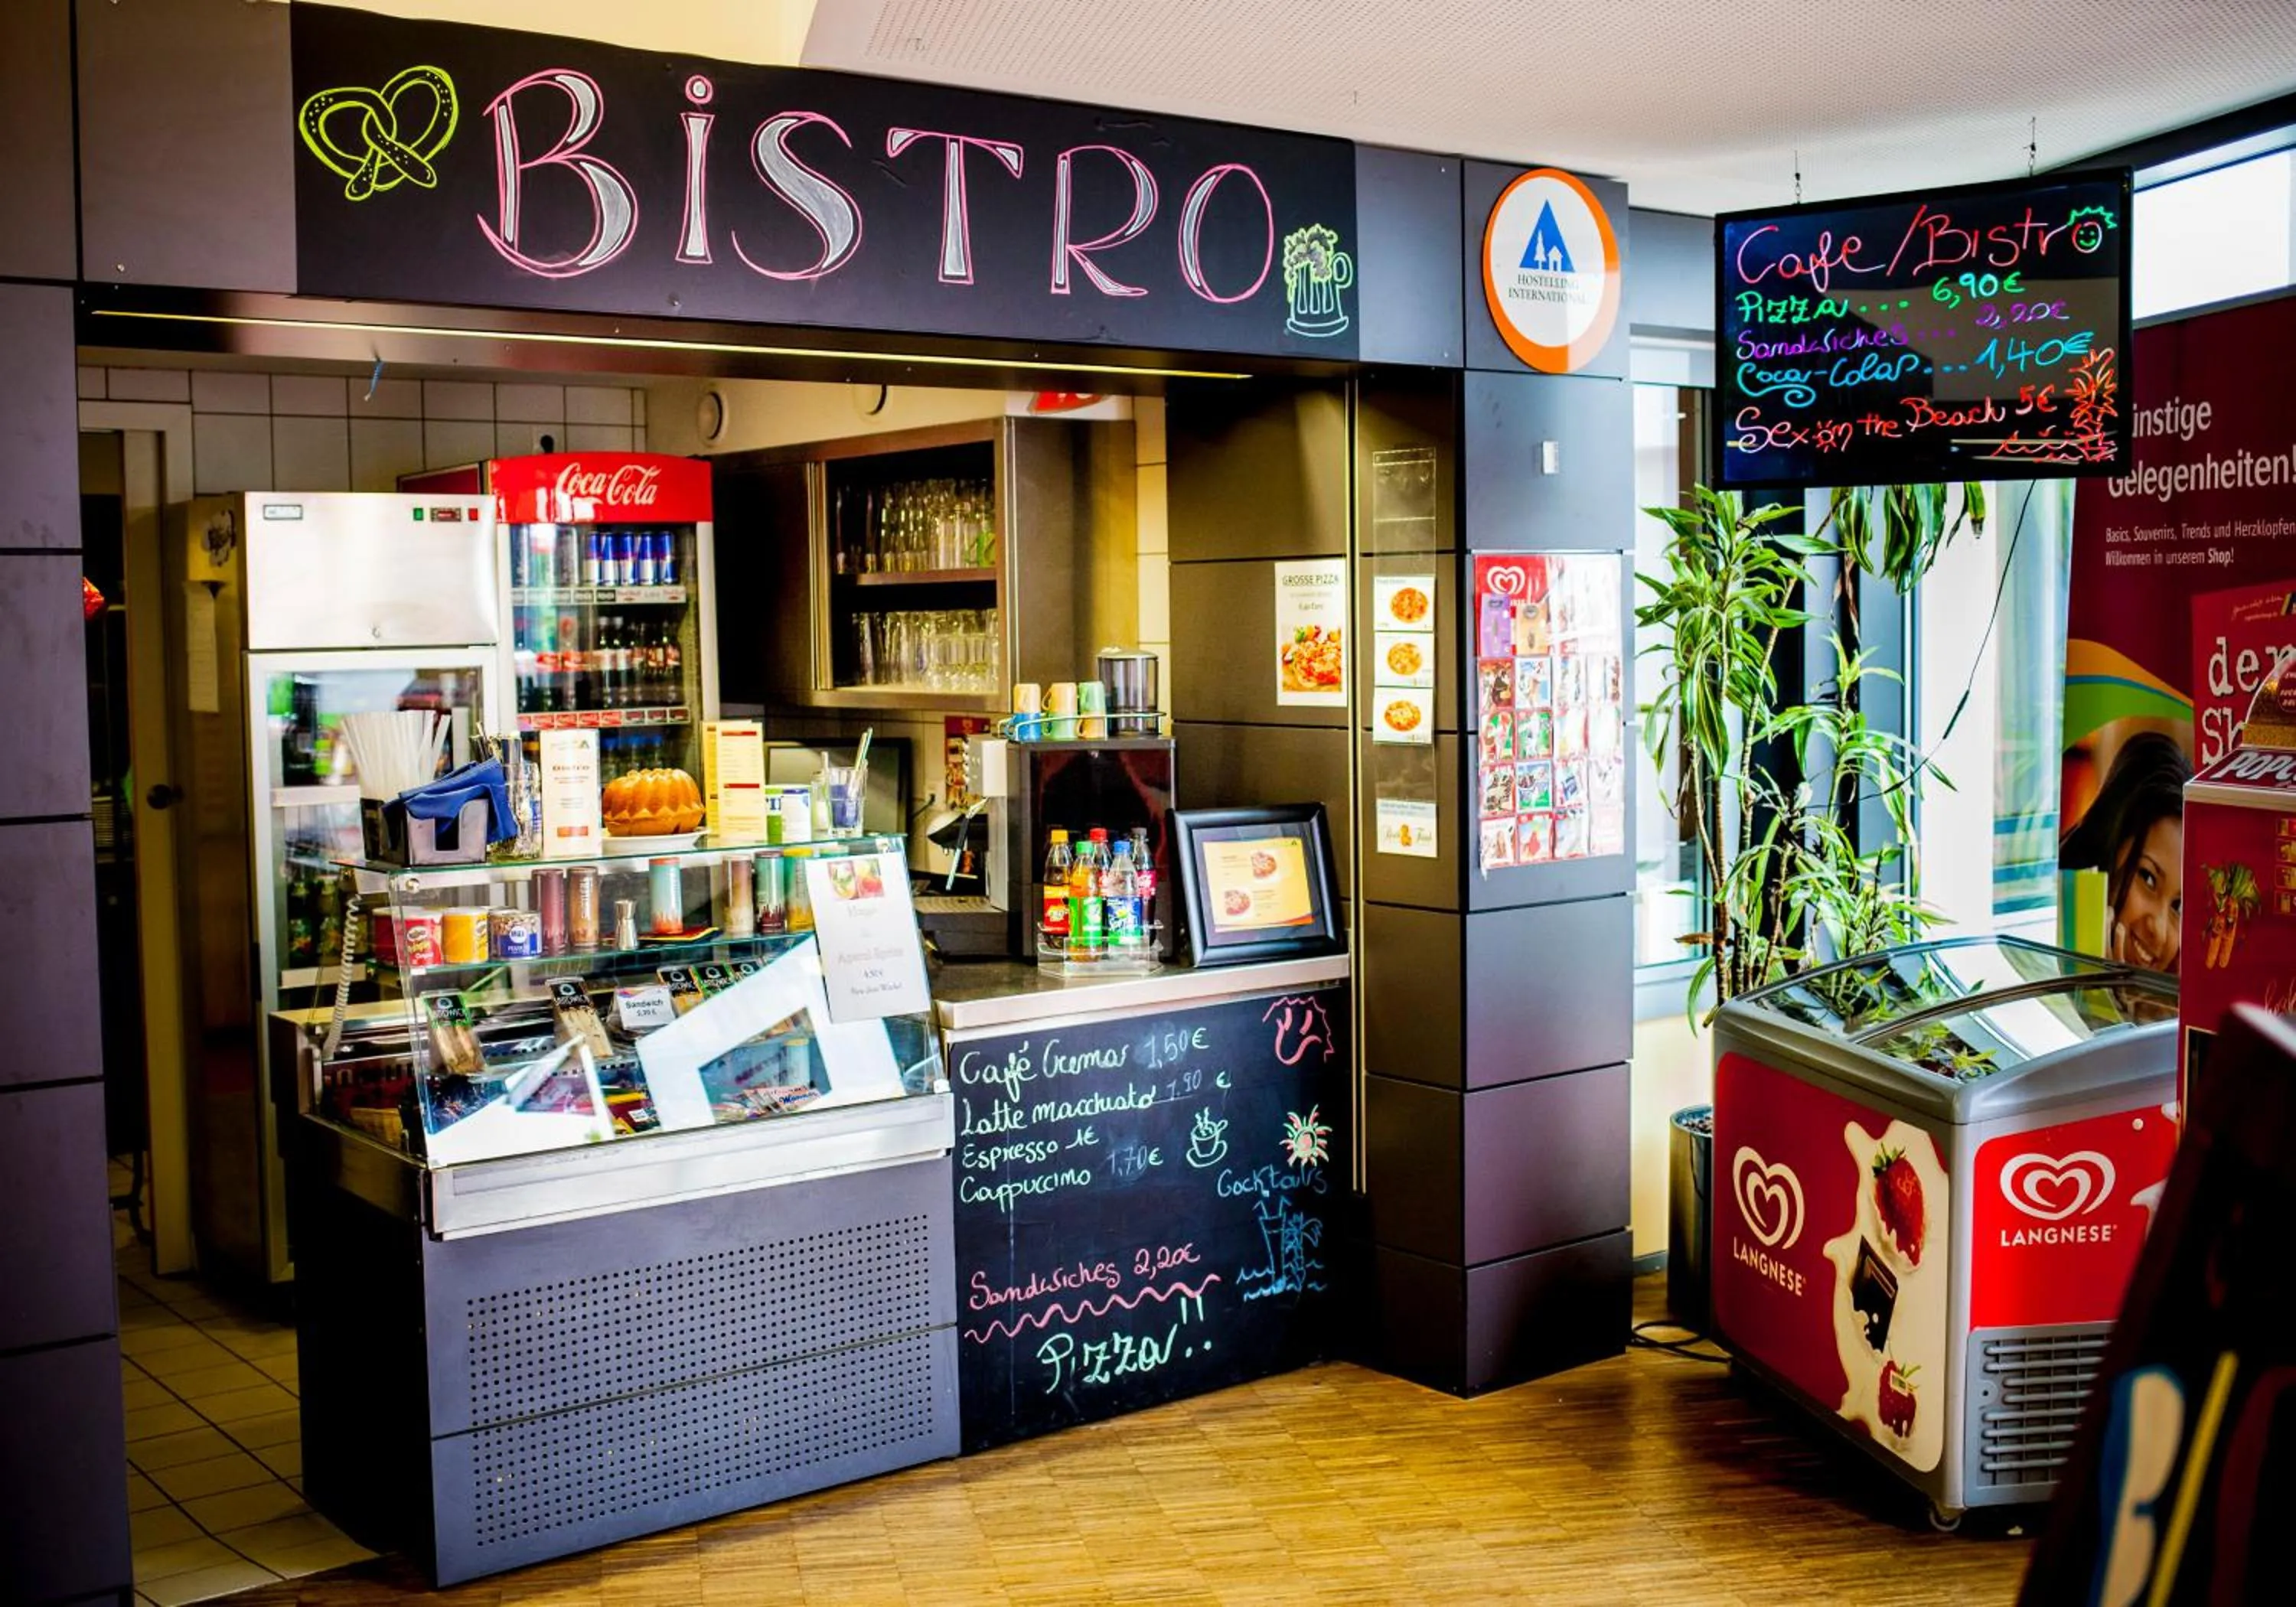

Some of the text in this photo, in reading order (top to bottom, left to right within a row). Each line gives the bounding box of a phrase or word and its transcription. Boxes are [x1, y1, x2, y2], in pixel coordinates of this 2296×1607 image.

[1735, 406, 1808, 453] Sex
[1858, 413, 1903, 438] the
[1900, 396, 2005, 432] Beach
[2132, 396, 2212, 441] nstige
[2182, 523, 2211, 539] Trends
[2214, 520, 2231, 538] und
[2154, 549, 2163, 565] in
[2166, 551, 2205, 565] unserem
[2208, 547, 2234, 567] Shop!
[625, 999, 664, 1009] Sandwich
[961, 1099, 1027, 1136] Latte
[962, 1137, 1058, 1172] Espresso
[960, 1168, 1091, 1212] Cappuccino
[1217, 1164, 1328, 1198] Cocktails
[1998, 1224, 2113, 1247] LANGNESE
[1733, 1236, 1803, 1296] LANGNESE
